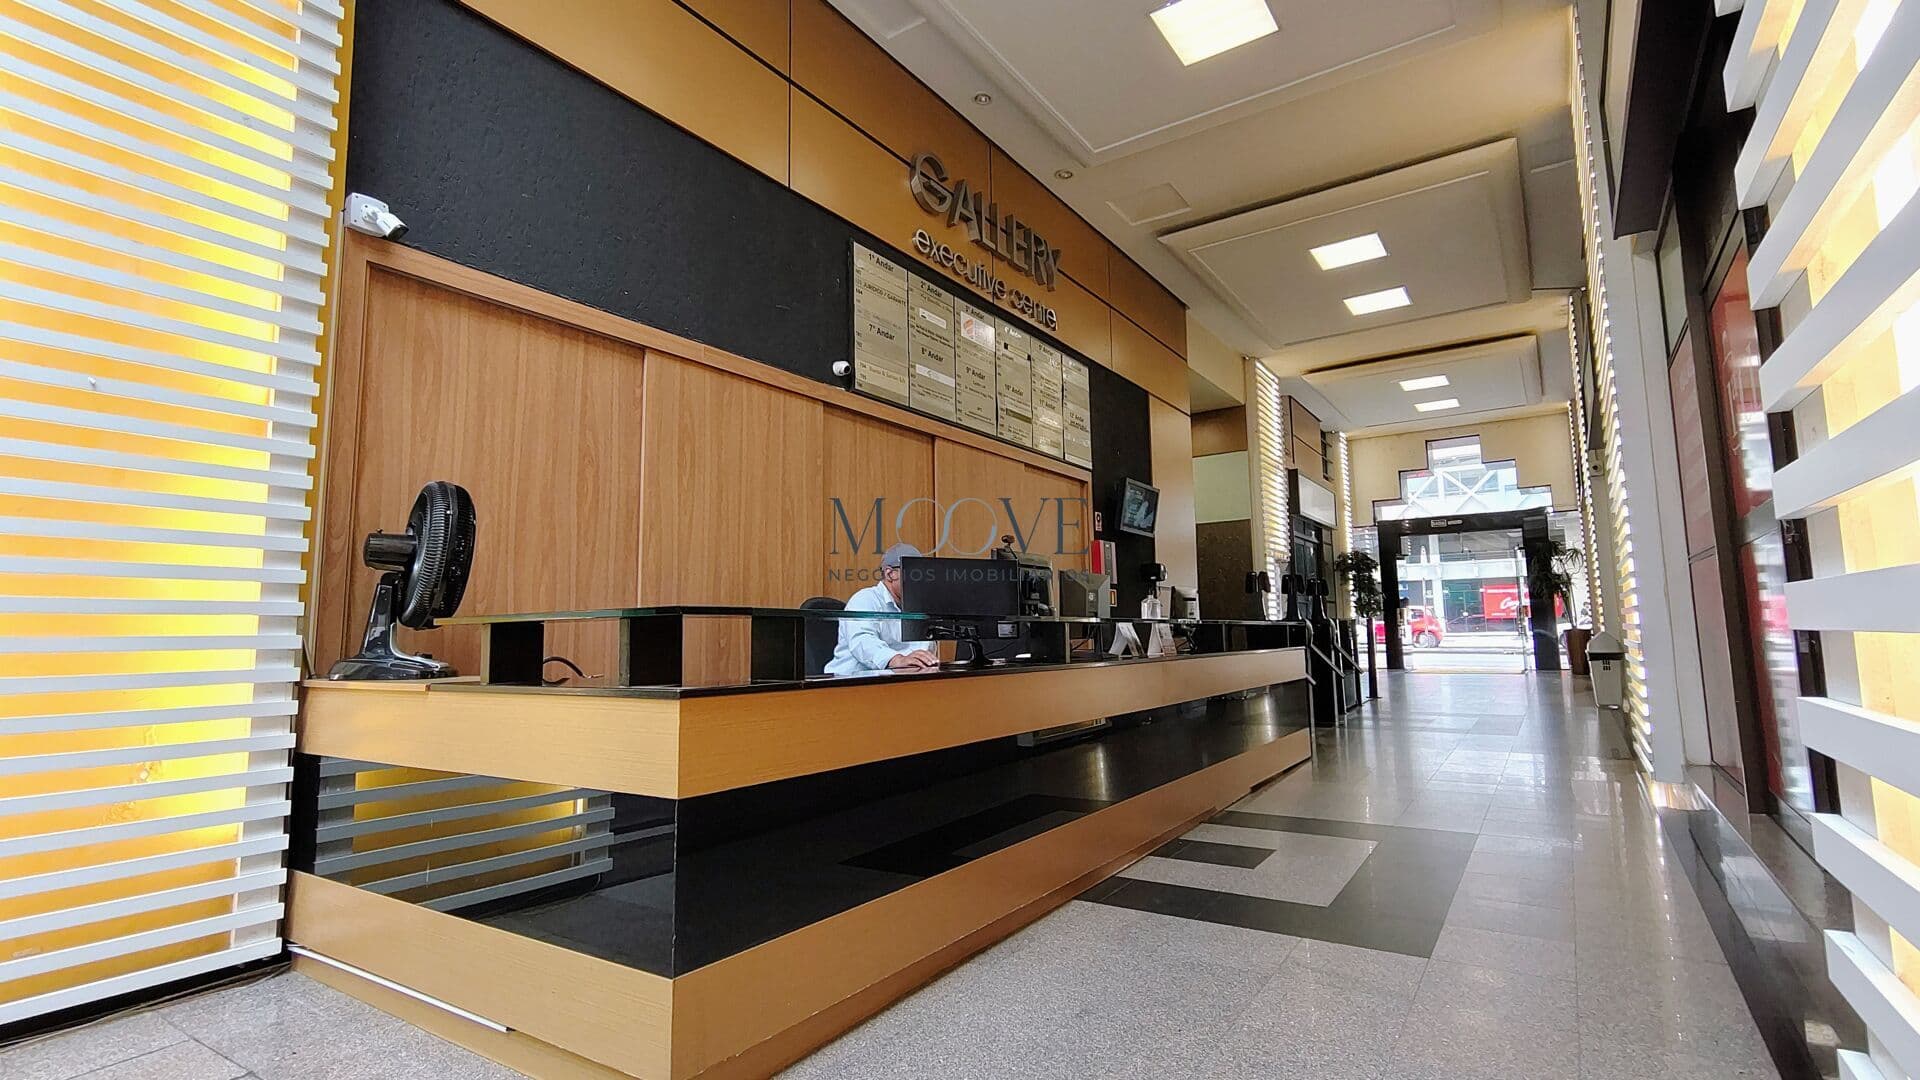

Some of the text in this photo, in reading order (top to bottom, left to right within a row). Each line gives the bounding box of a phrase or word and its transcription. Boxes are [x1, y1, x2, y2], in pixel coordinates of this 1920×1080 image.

[909, 152, 1062, 292] GALLERY
[875, 257, 895, 272] Andar
[912, 228, 1007, 299] executive
[926, 285, 943, 298] Andar
[876, 327, 895, 341] Andar
[927, 350, 944, 362] Andar
